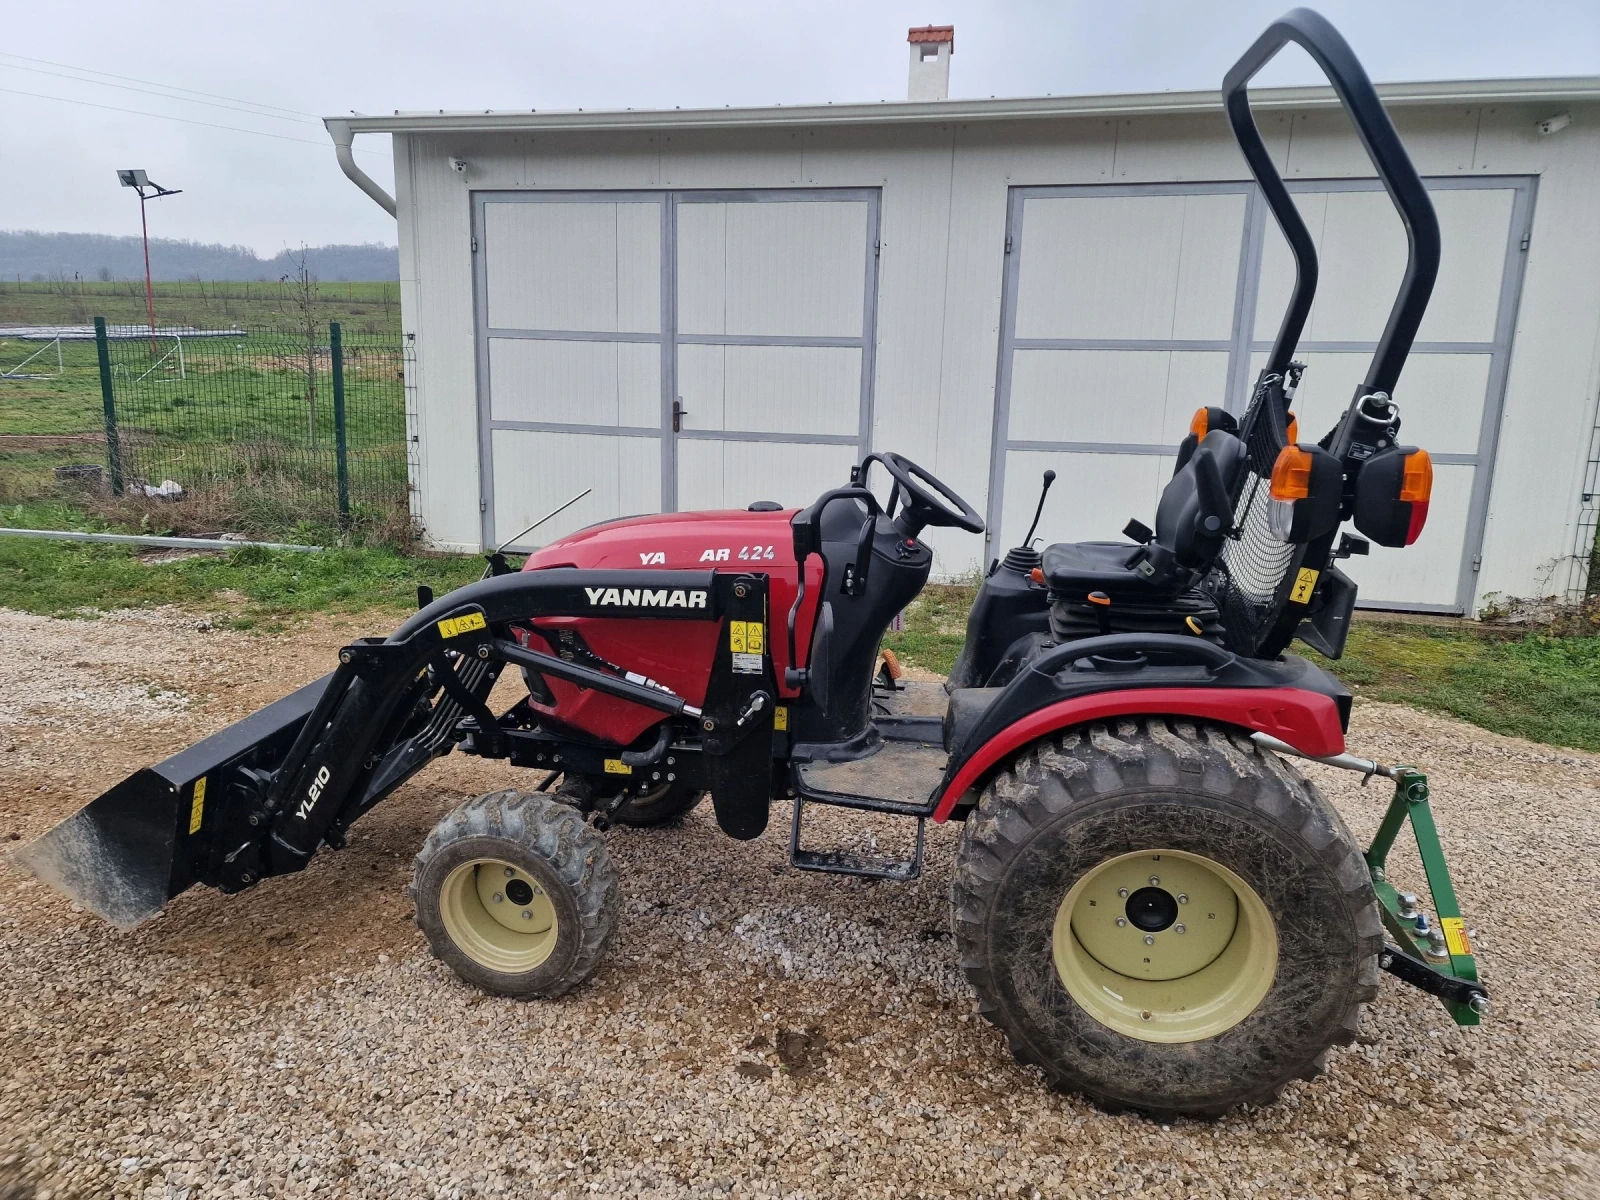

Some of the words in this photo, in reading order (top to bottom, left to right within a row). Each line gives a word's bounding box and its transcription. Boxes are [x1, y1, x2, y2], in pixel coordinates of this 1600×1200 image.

[738, 545, 775, 560] 424
[584, 587, 708, 609] YANMAR
[296, 766, 330, 820] YL210
